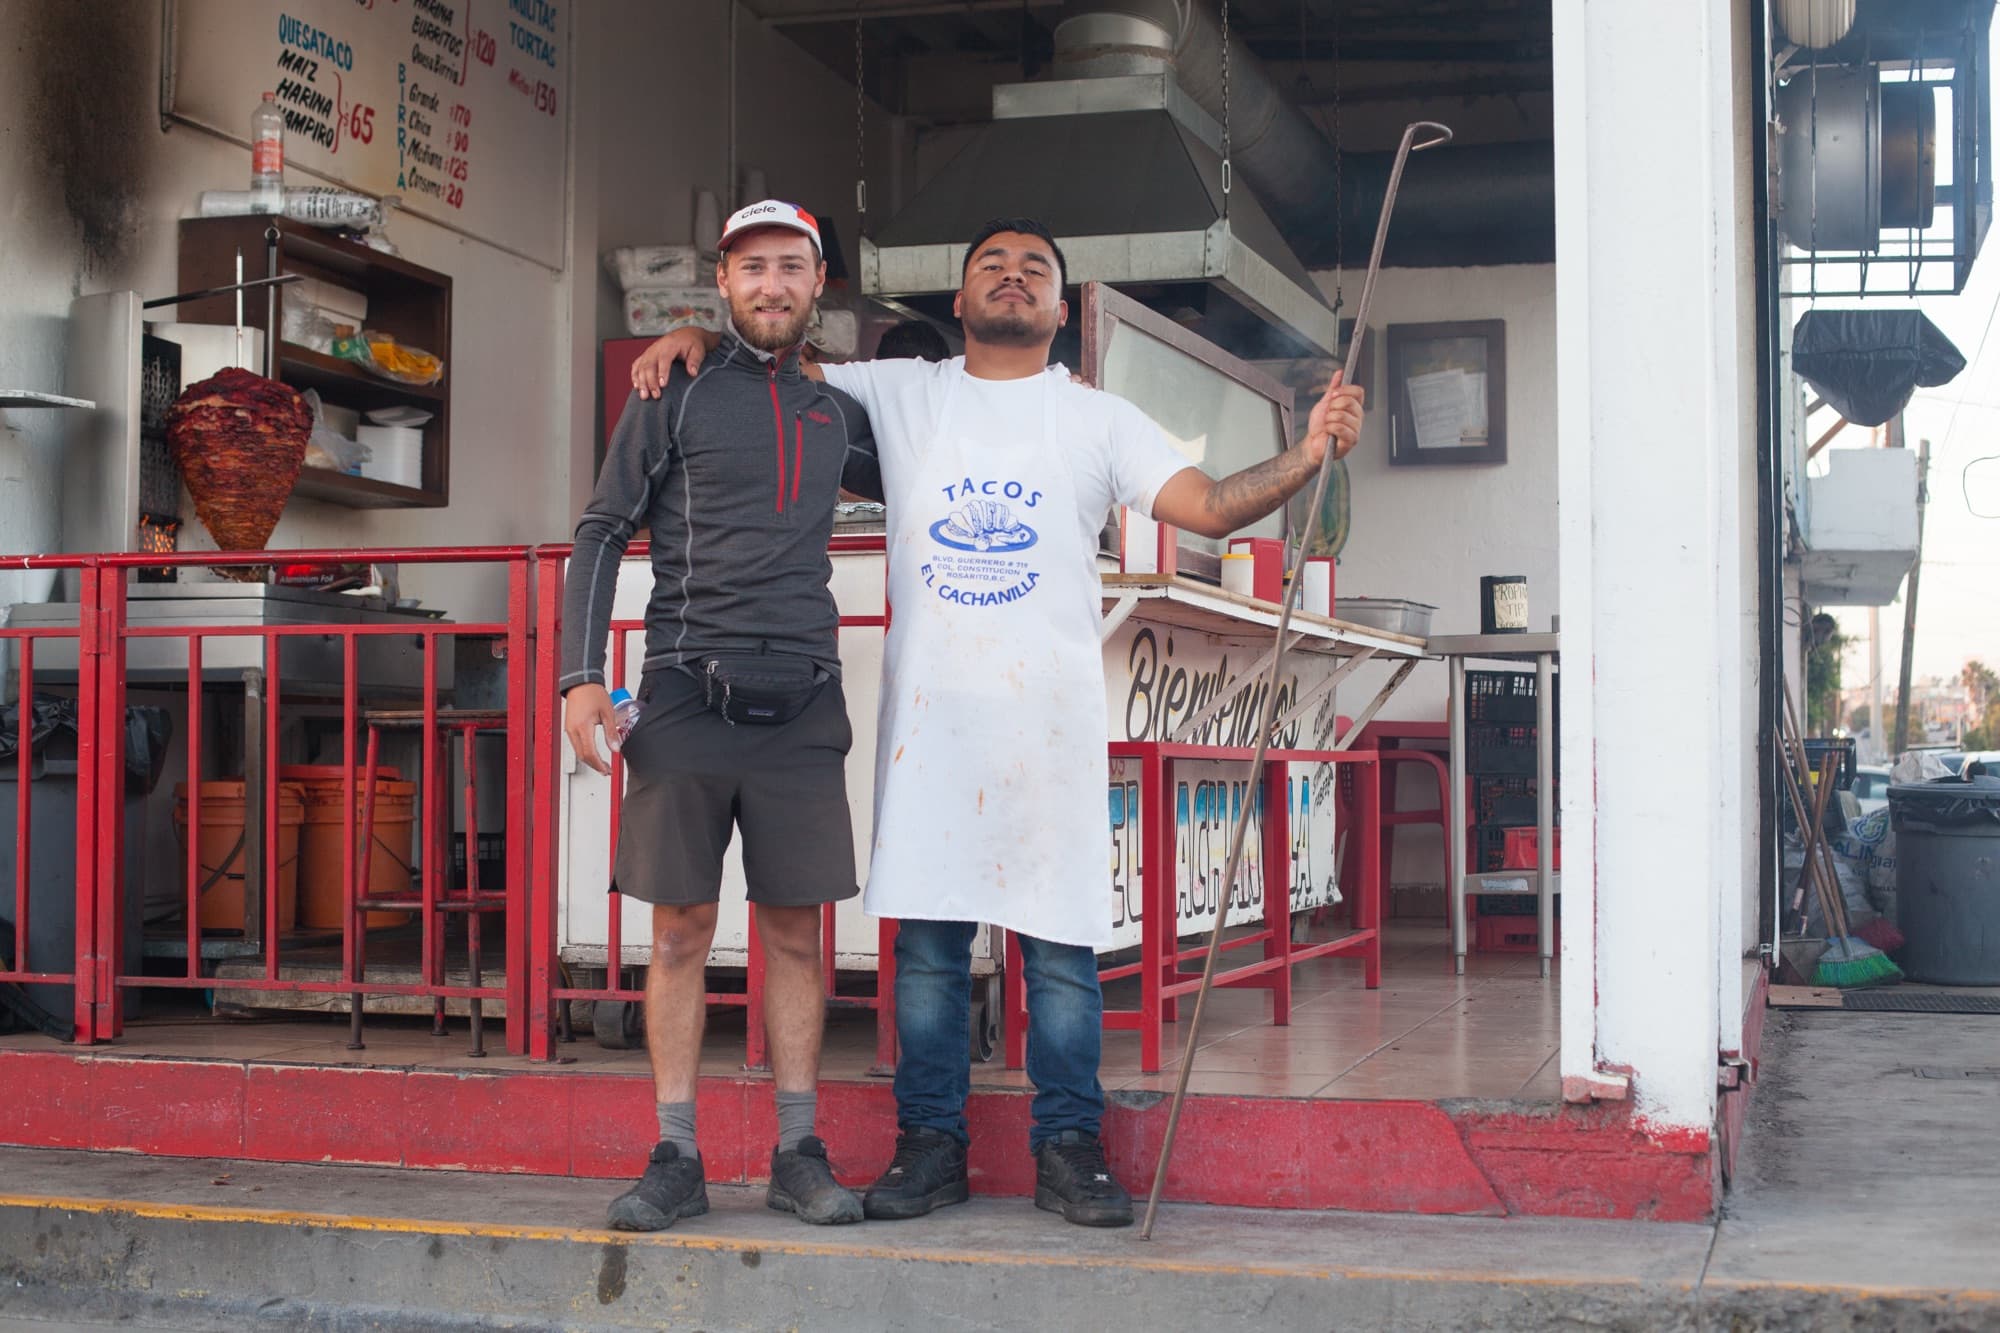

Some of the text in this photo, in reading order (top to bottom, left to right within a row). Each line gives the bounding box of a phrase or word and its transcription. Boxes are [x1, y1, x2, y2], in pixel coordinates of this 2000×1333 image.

[278, 13, 353, 72] QUESATACO
[411, 15, 463, 56] BURRITOS
[509, 21, 556, 69] TORTAS
[277, 49, 319, 82] MAIZ
[276, 77, 333, 119] HARINA
[741, 205, 777, 219] ciele
[942, 477, 1043, 508] TACOS
[920, 563, 1040, 607] EL CACHANILLA
